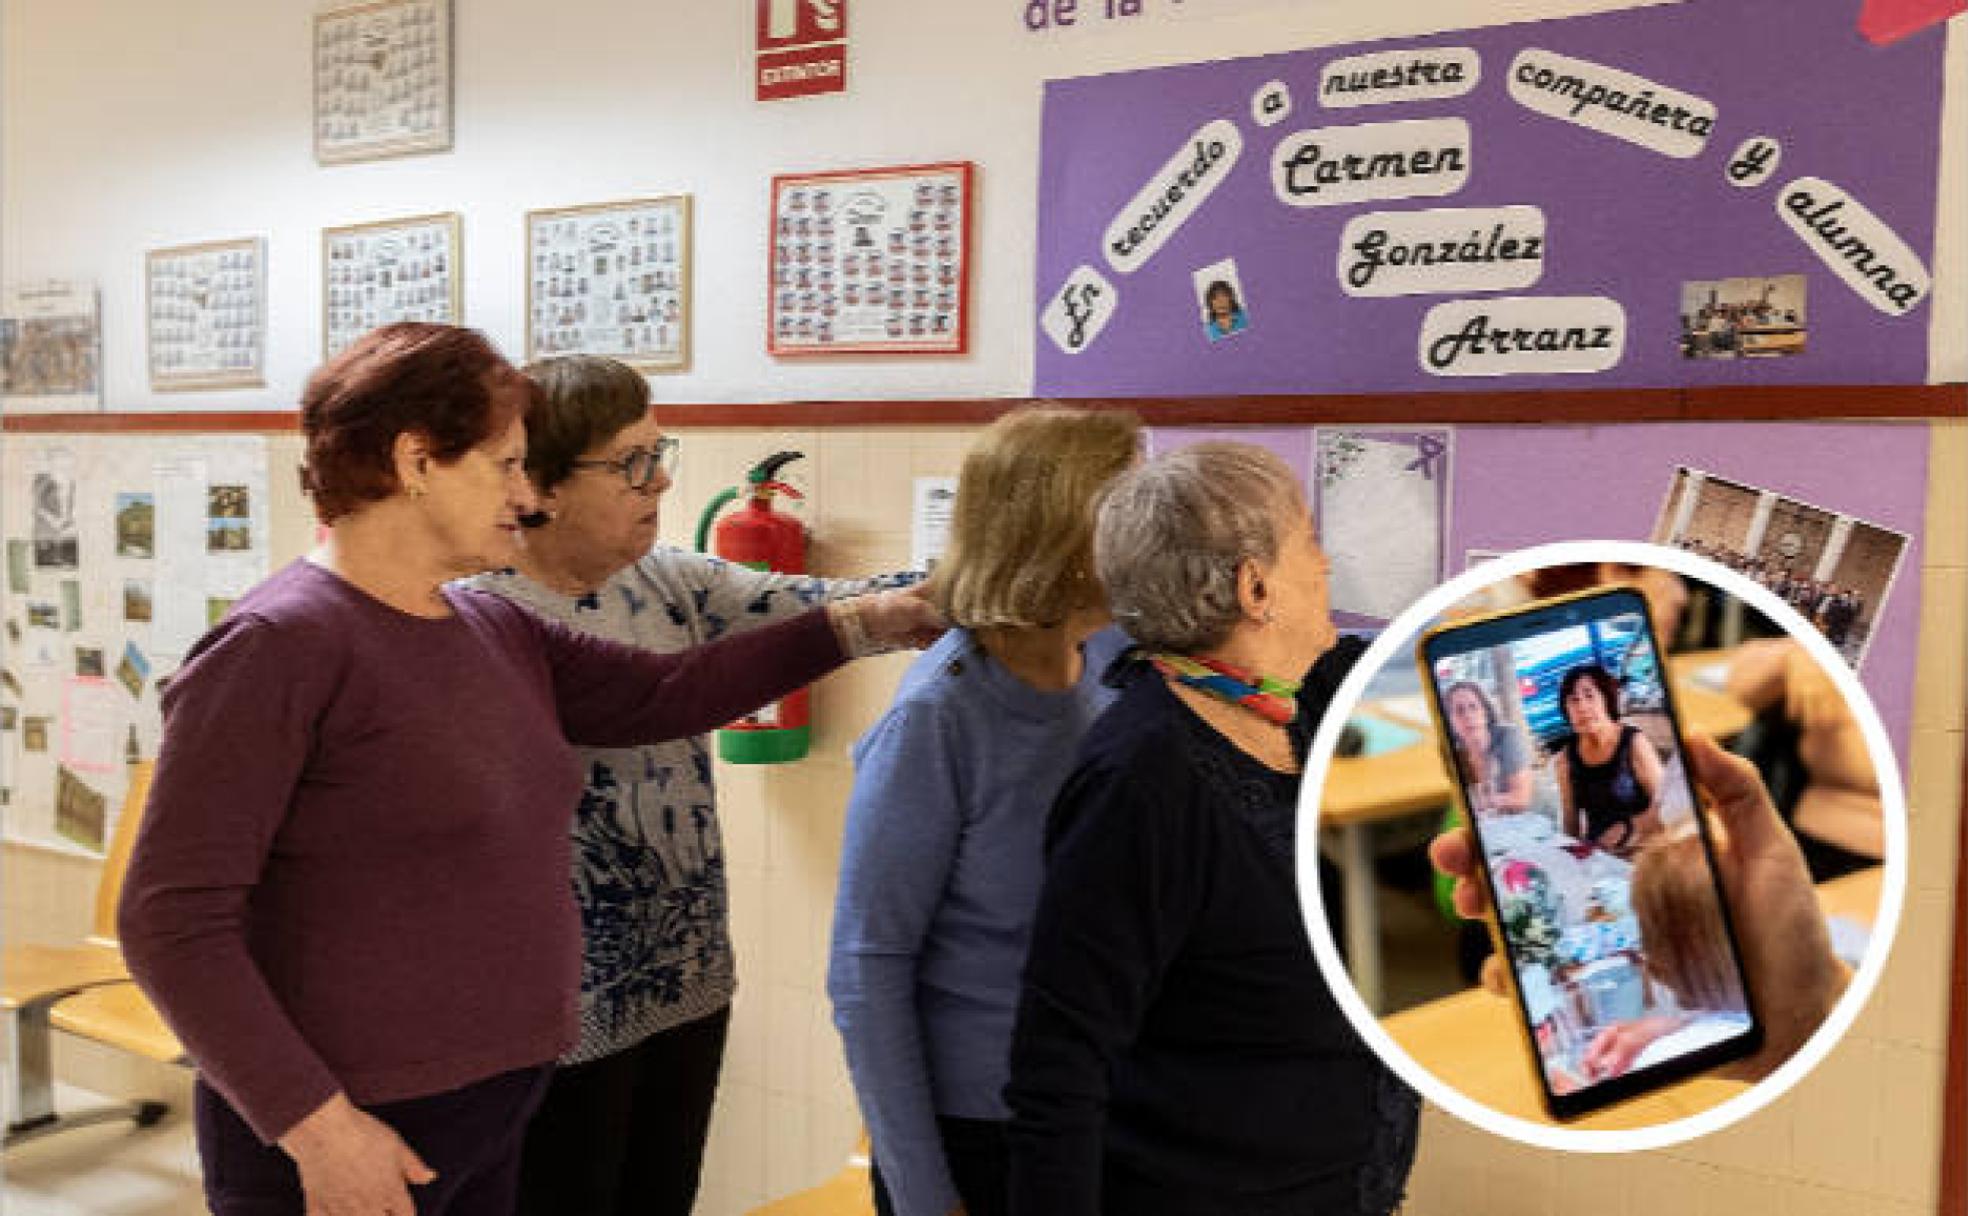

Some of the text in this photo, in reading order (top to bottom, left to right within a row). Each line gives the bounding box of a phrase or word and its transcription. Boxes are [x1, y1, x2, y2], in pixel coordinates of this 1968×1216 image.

[1024, 0, 1077, 31] de
[1282, 144, 1465, 195] Carmen
[1062, 60, 1917, 348] En recuerdo a nuestra compañera y alumna
[1349, 224, 1542, 287] González
[1427, 315, 1613, 368] Arranz
